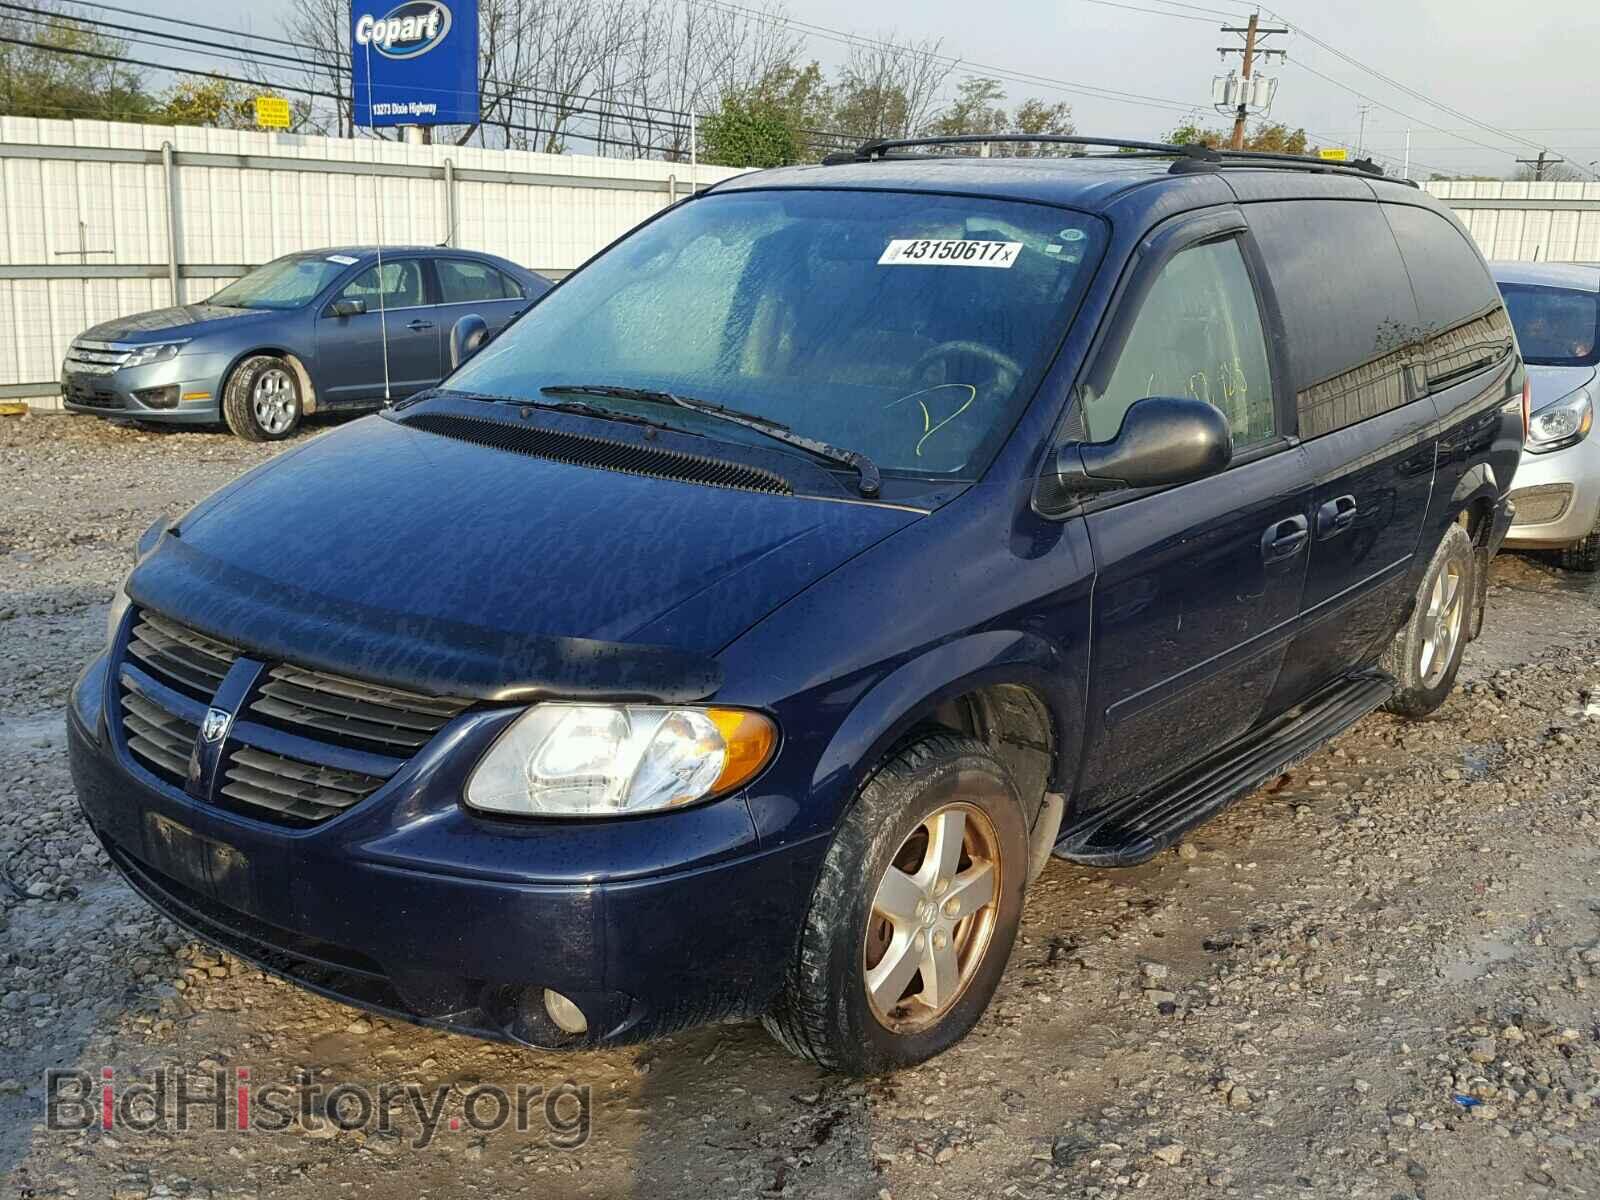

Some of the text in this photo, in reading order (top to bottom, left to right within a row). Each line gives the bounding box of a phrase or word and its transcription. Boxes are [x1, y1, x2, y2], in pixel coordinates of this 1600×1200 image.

[356, 7, 440, 48] Copart
[392, 103, 408, 115] Dixie
[409, 101, 437, 117] Highway
